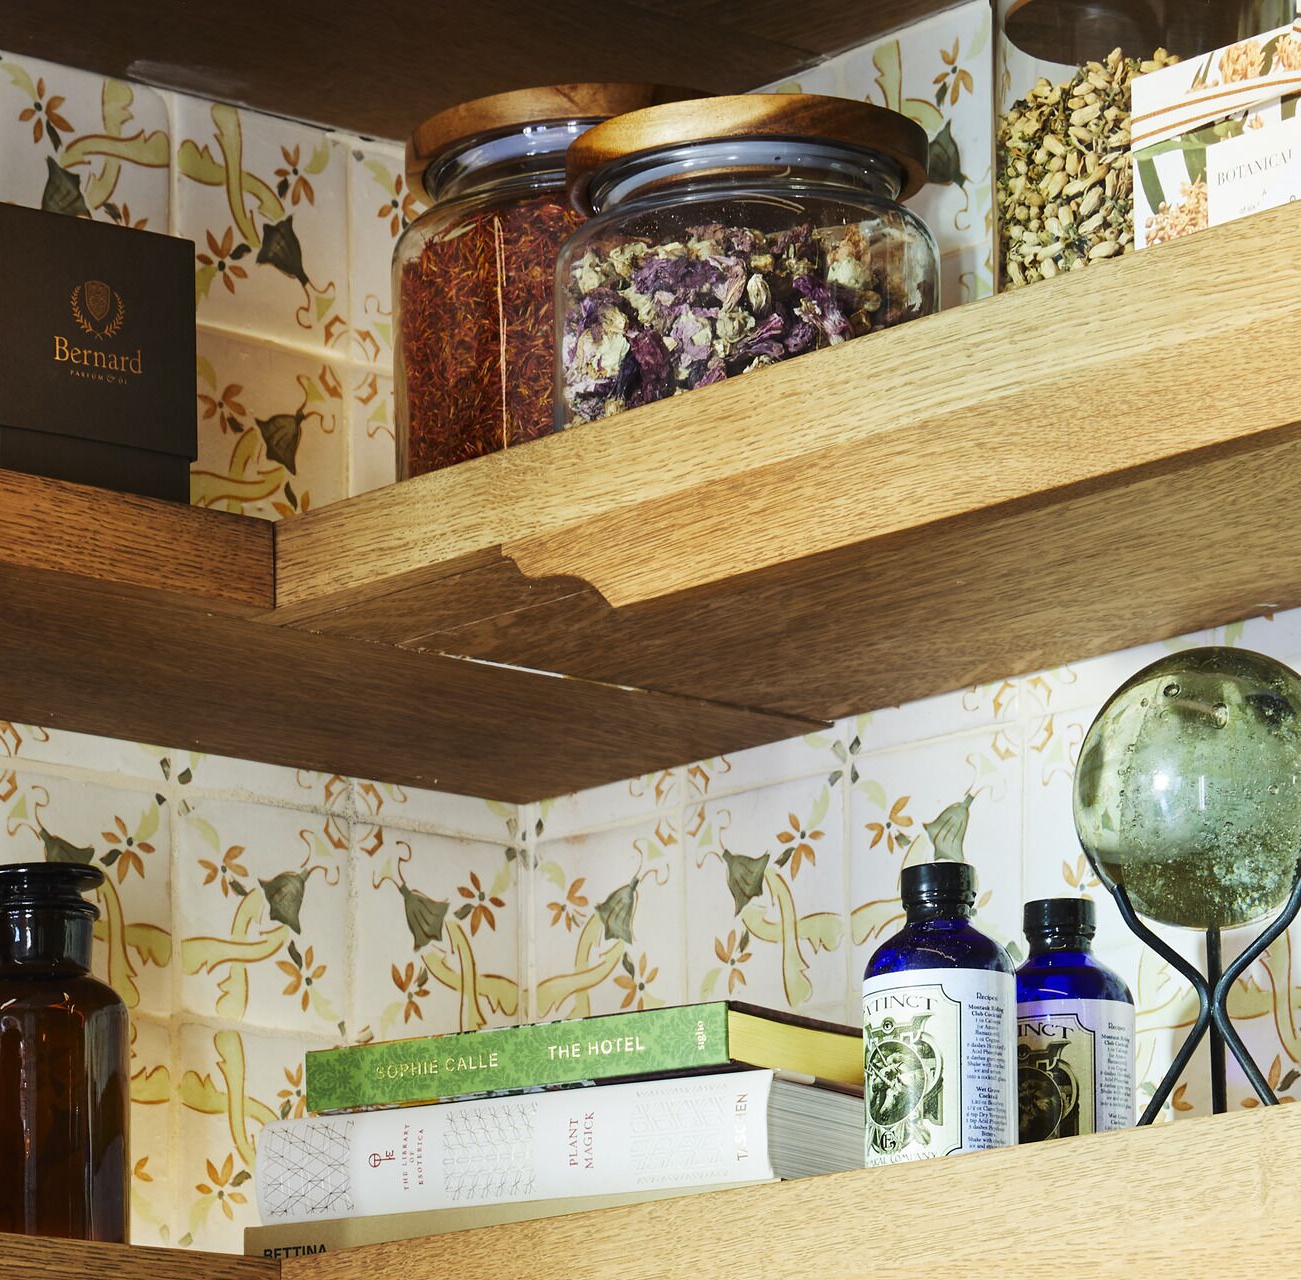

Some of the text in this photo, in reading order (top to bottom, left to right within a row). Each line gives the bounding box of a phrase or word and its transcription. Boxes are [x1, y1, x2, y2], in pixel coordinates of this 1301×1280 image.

[53, 336, 142, 375] Bernard
[976, 992, 998, 1001] Recipes
[548, 1036, 645, 1061] THE HOTEL
[695, 1020, 707, 1051] siglio
[376, 1052, 498, 1080] SOPHIE CALLE
[402, 1124, 410, 1167] LIBRARY
[416, 1129, 424, 1185] ESOTERICA
[569, 1118, 579, 1166] PLANT
[583, 1111, 595, 1169] MAGICK
[264, 1244, 327, 1259] BETTINA
